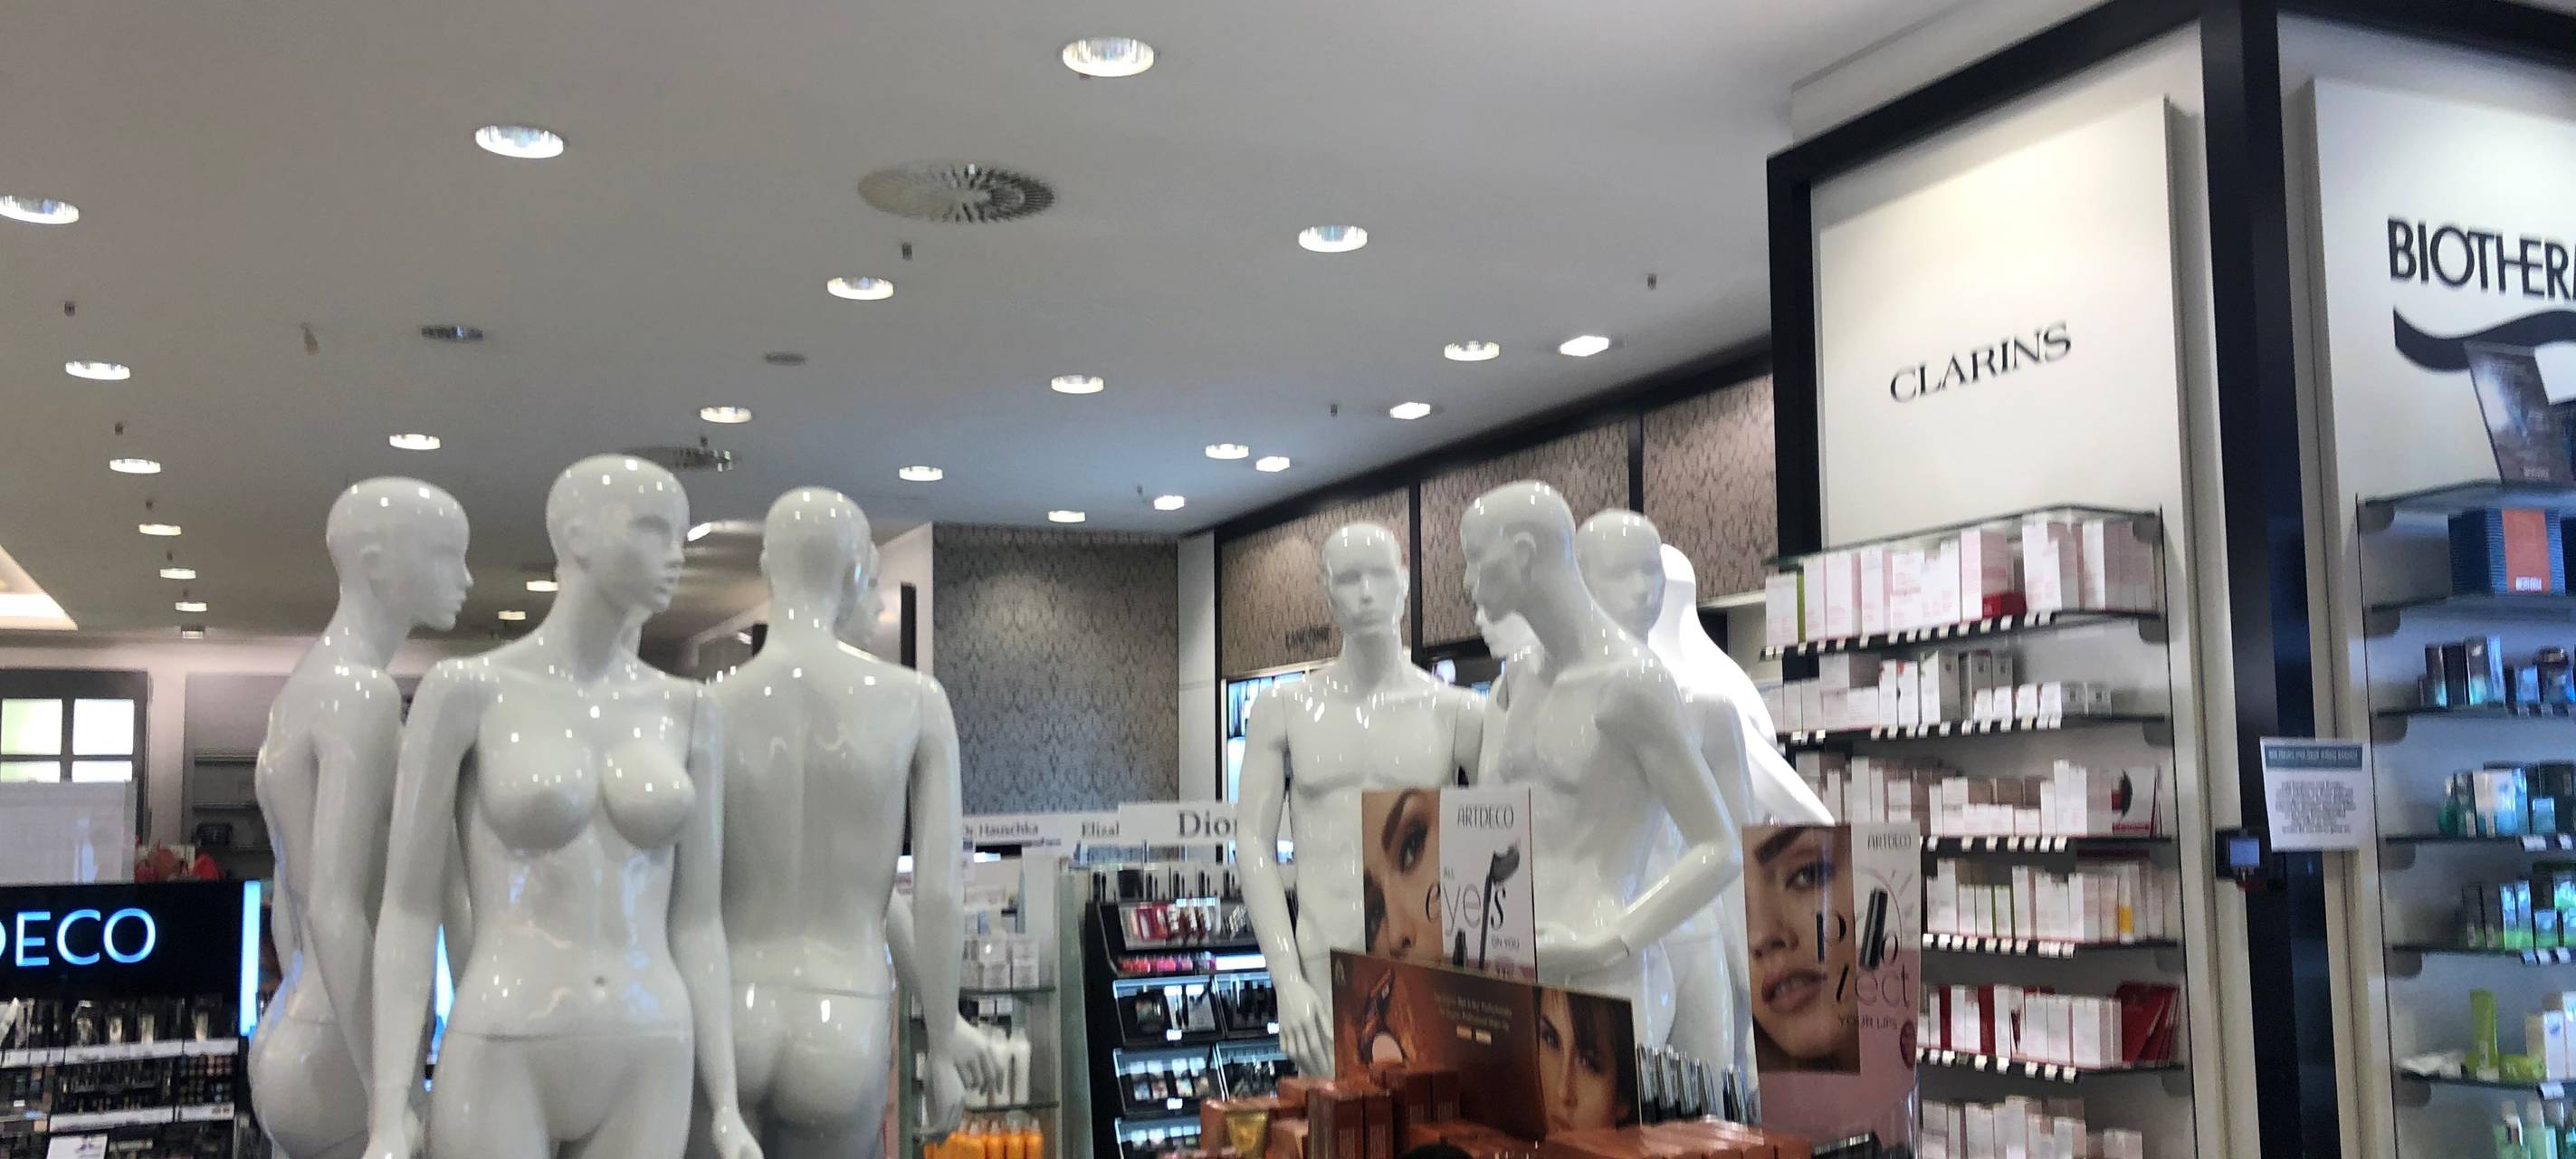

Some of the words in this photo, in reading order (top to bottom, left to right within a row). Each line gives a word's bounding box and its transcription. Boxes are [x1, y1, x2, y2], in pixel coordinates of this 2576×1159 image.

[2387, 216, 2576, 301] BIOTHER
[1889, 321, 2072, 403] CLARINS
[1456, 803, 1514, 828] ARTDECO
[0, 907, 157, 966] ECO
